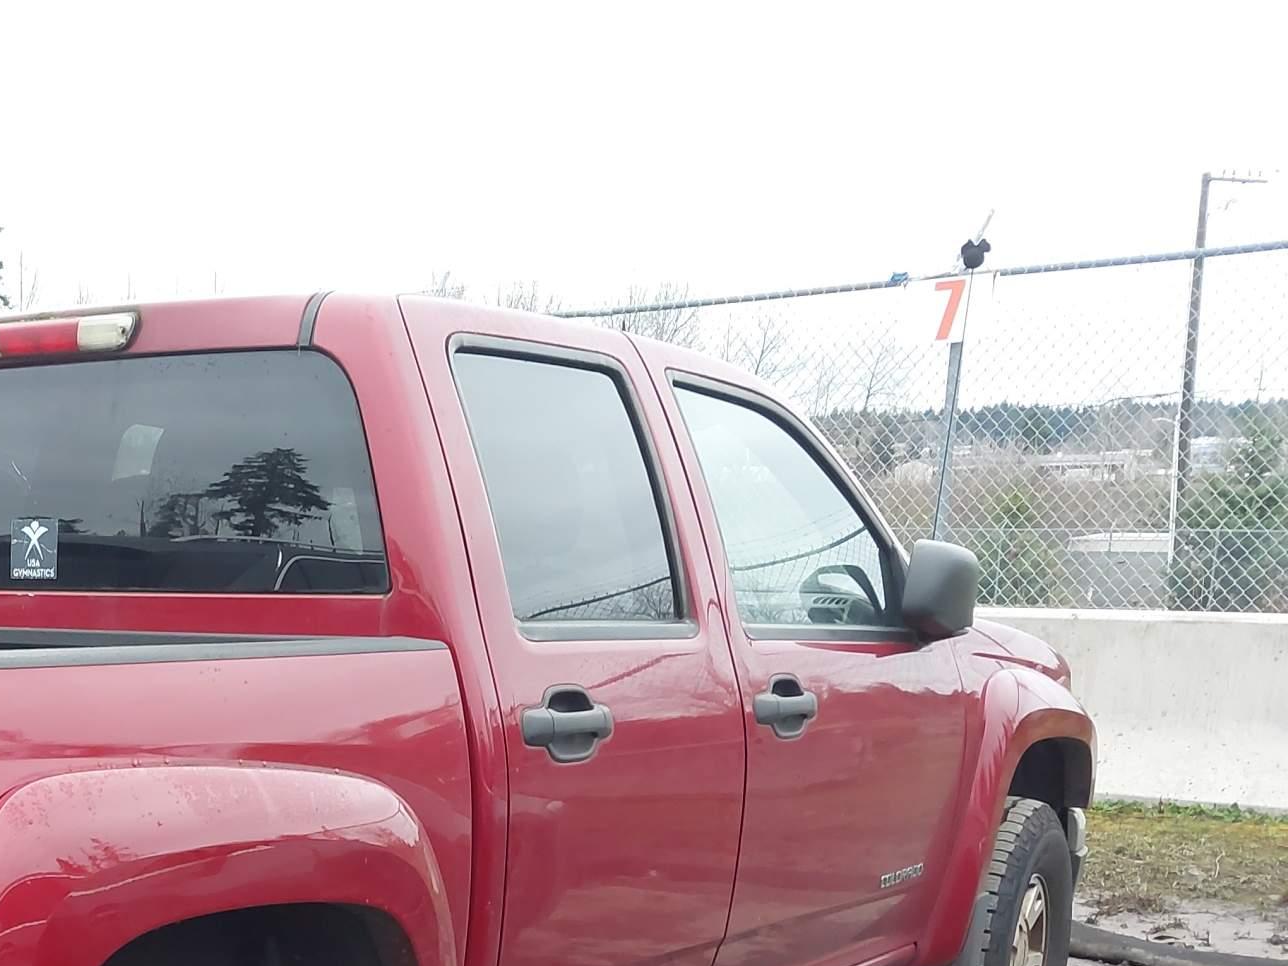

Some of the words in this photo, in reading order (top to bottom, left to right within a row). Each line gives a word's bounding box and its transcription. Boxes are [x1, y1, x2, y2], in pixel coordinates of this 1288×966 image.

[934, 279, 966, 341] 7
[27, 559, 41, 568] USA
[13, 568, 55, 578] GYMNASTICS
